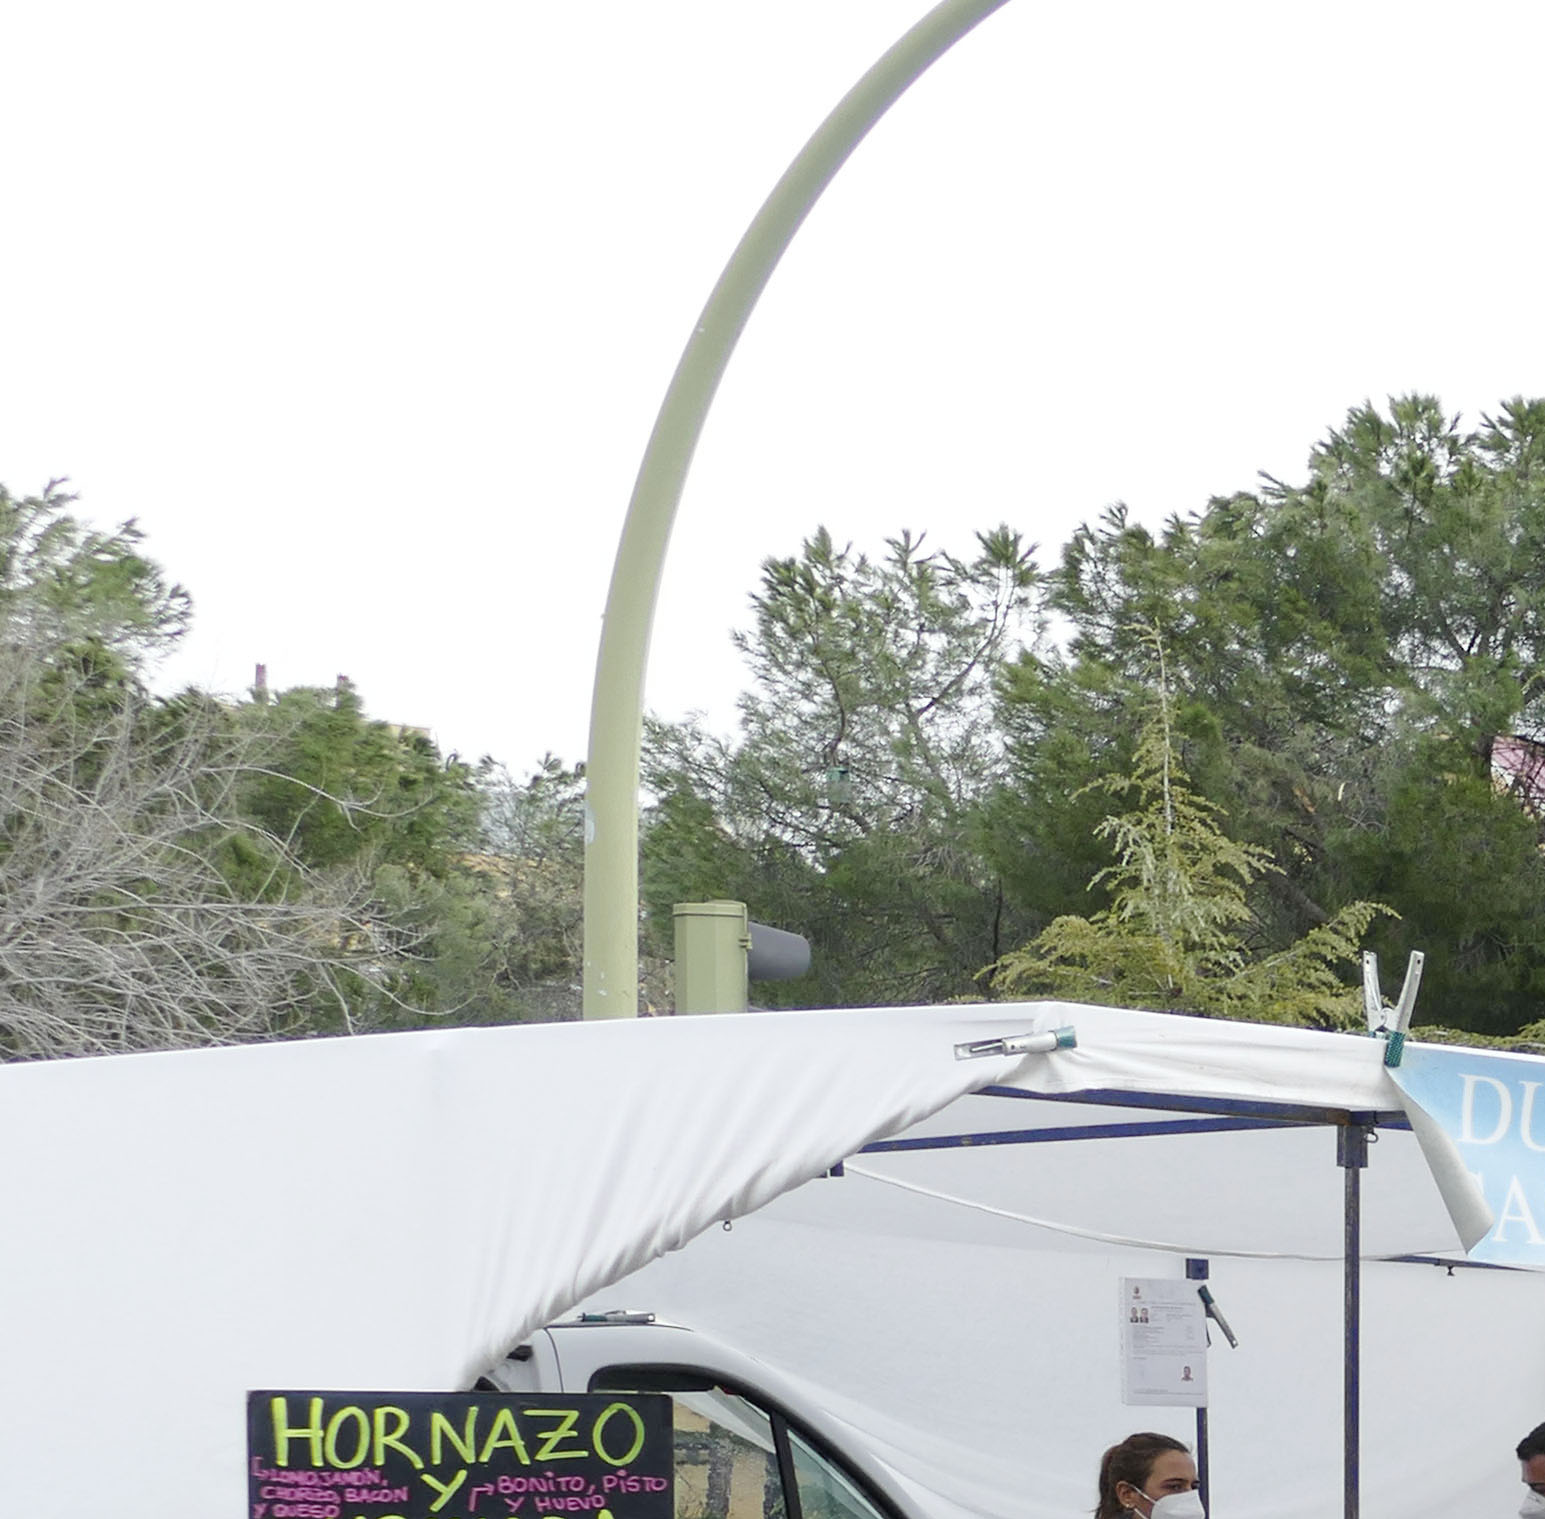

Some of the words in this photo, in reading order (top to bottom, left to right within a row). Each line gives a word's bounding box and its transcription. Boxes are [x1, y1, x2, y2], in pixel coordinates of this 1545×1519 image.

[270, 1397, 646, 1470] HORNAZO
[420, 1469, 468, 1512] Y
[497, 1471, 596, 1496] BONITO,
[602, 1469, 668, 1494] PISTO
[504, 1497, 525, 1513] Y
[535, 1495, 606, 1512] HUEVO
